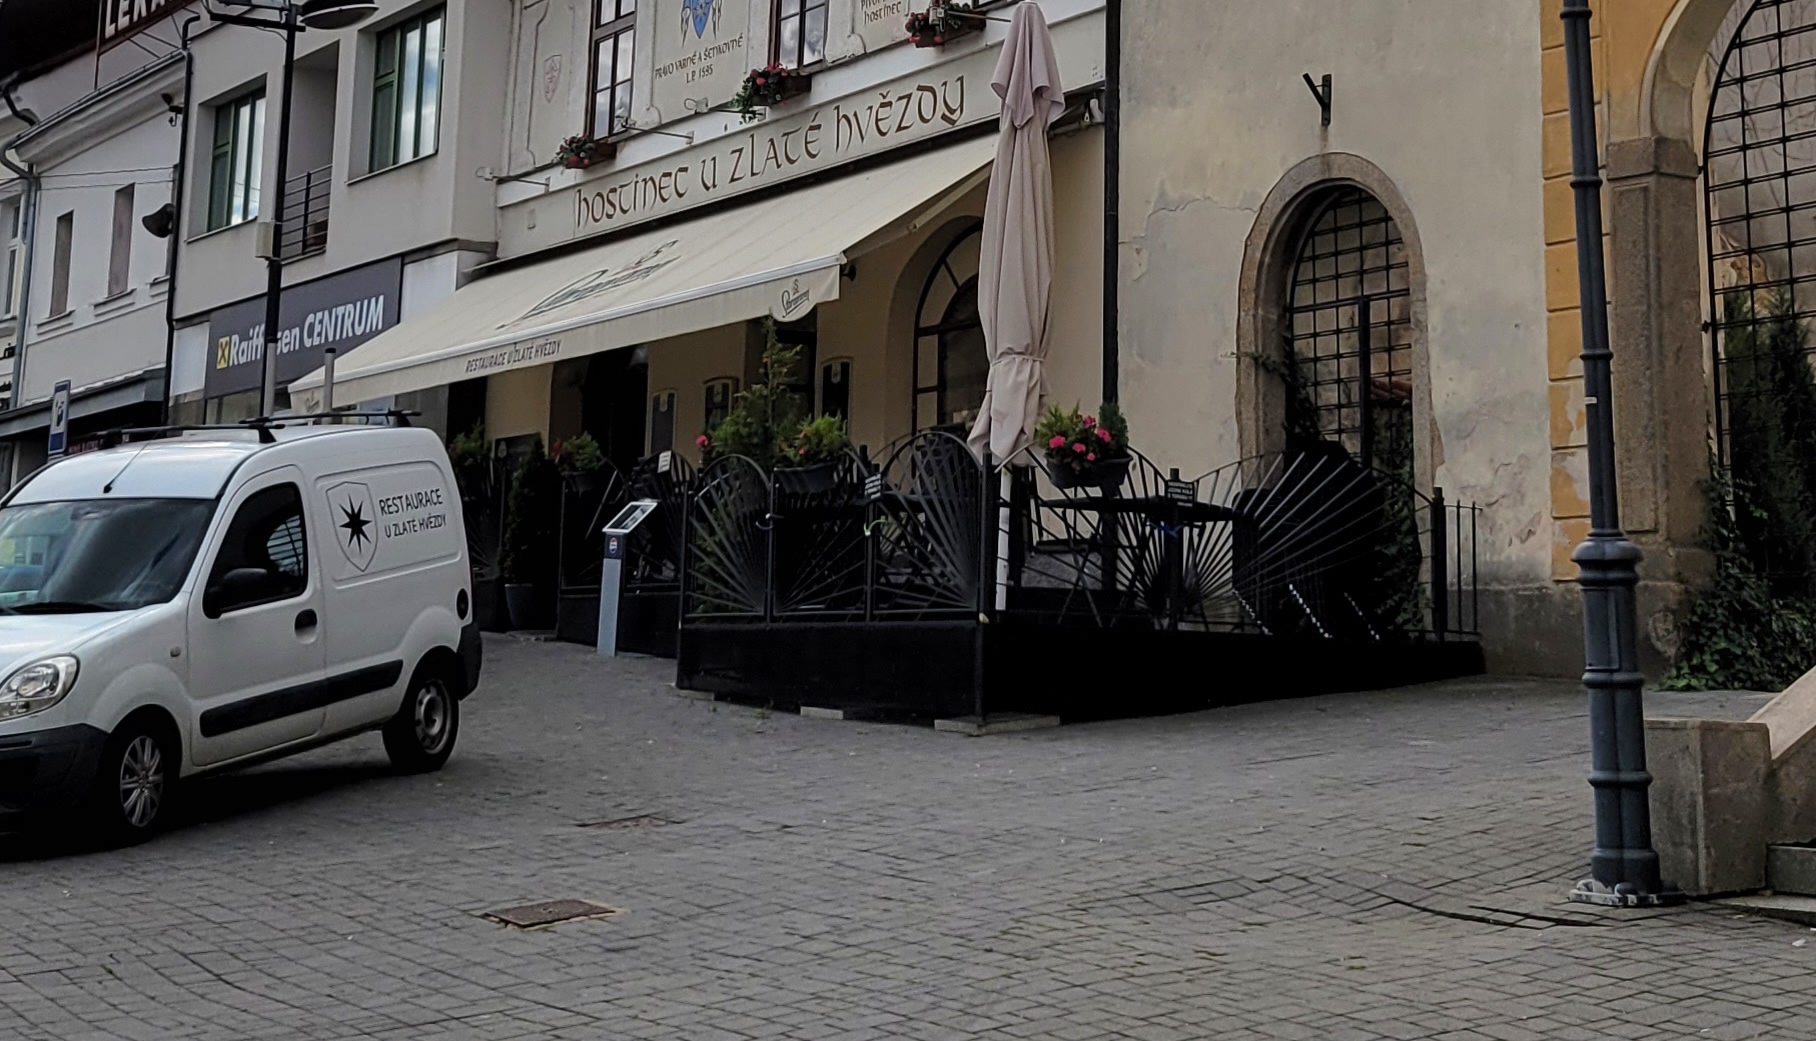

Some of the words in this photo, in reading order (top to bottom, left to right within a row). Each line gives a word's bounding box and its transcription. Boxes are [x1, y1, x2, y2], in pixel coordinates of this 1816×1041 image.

[303, 294, 385, 348] CENTRUM
[465, 351, 508, 373] RESTAURACE
[378, 488, 443, 516] RESTAURACE
[384, 524, 392, 538] U
